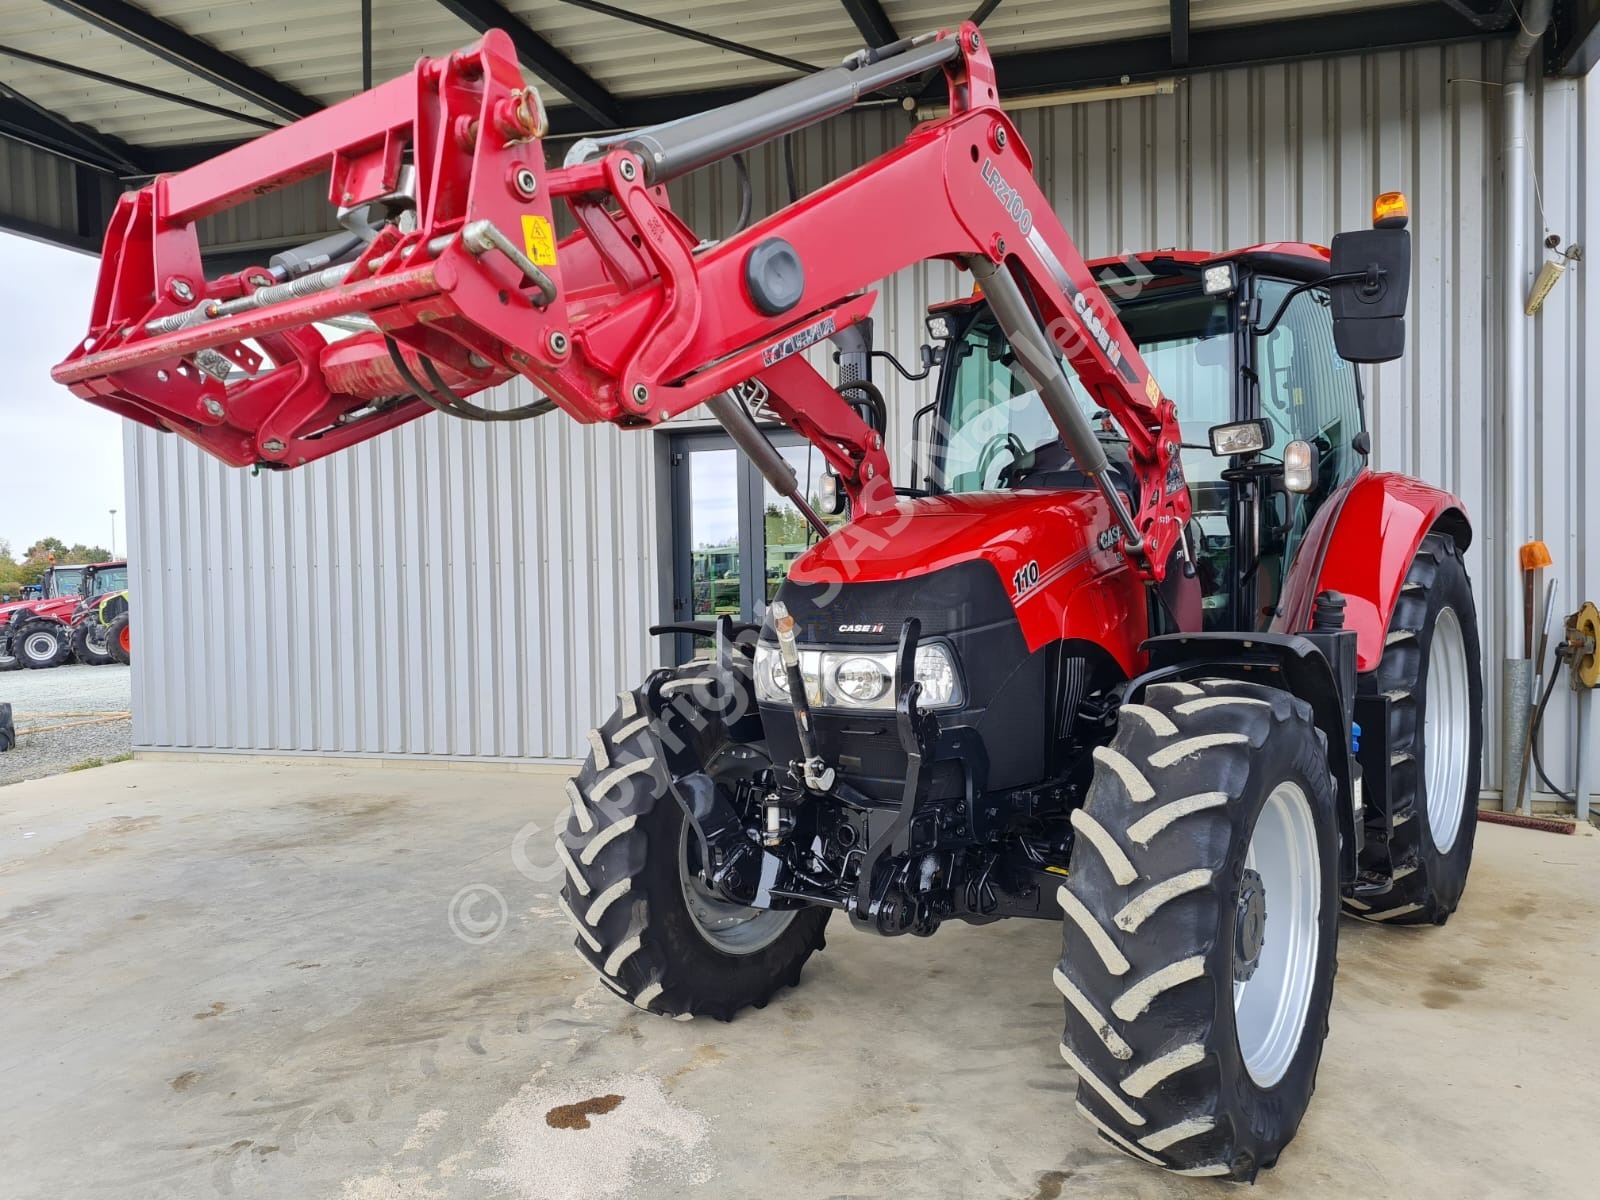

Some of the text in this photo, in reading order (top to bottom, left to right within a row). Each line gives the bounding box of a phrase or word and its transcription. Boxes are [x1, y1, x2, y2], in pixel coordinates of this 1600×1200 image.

[1074, 292, 1110, 352] CASE
[1013, 559, 1039, 597] 110
[839, 624, 871, 633] CASE
